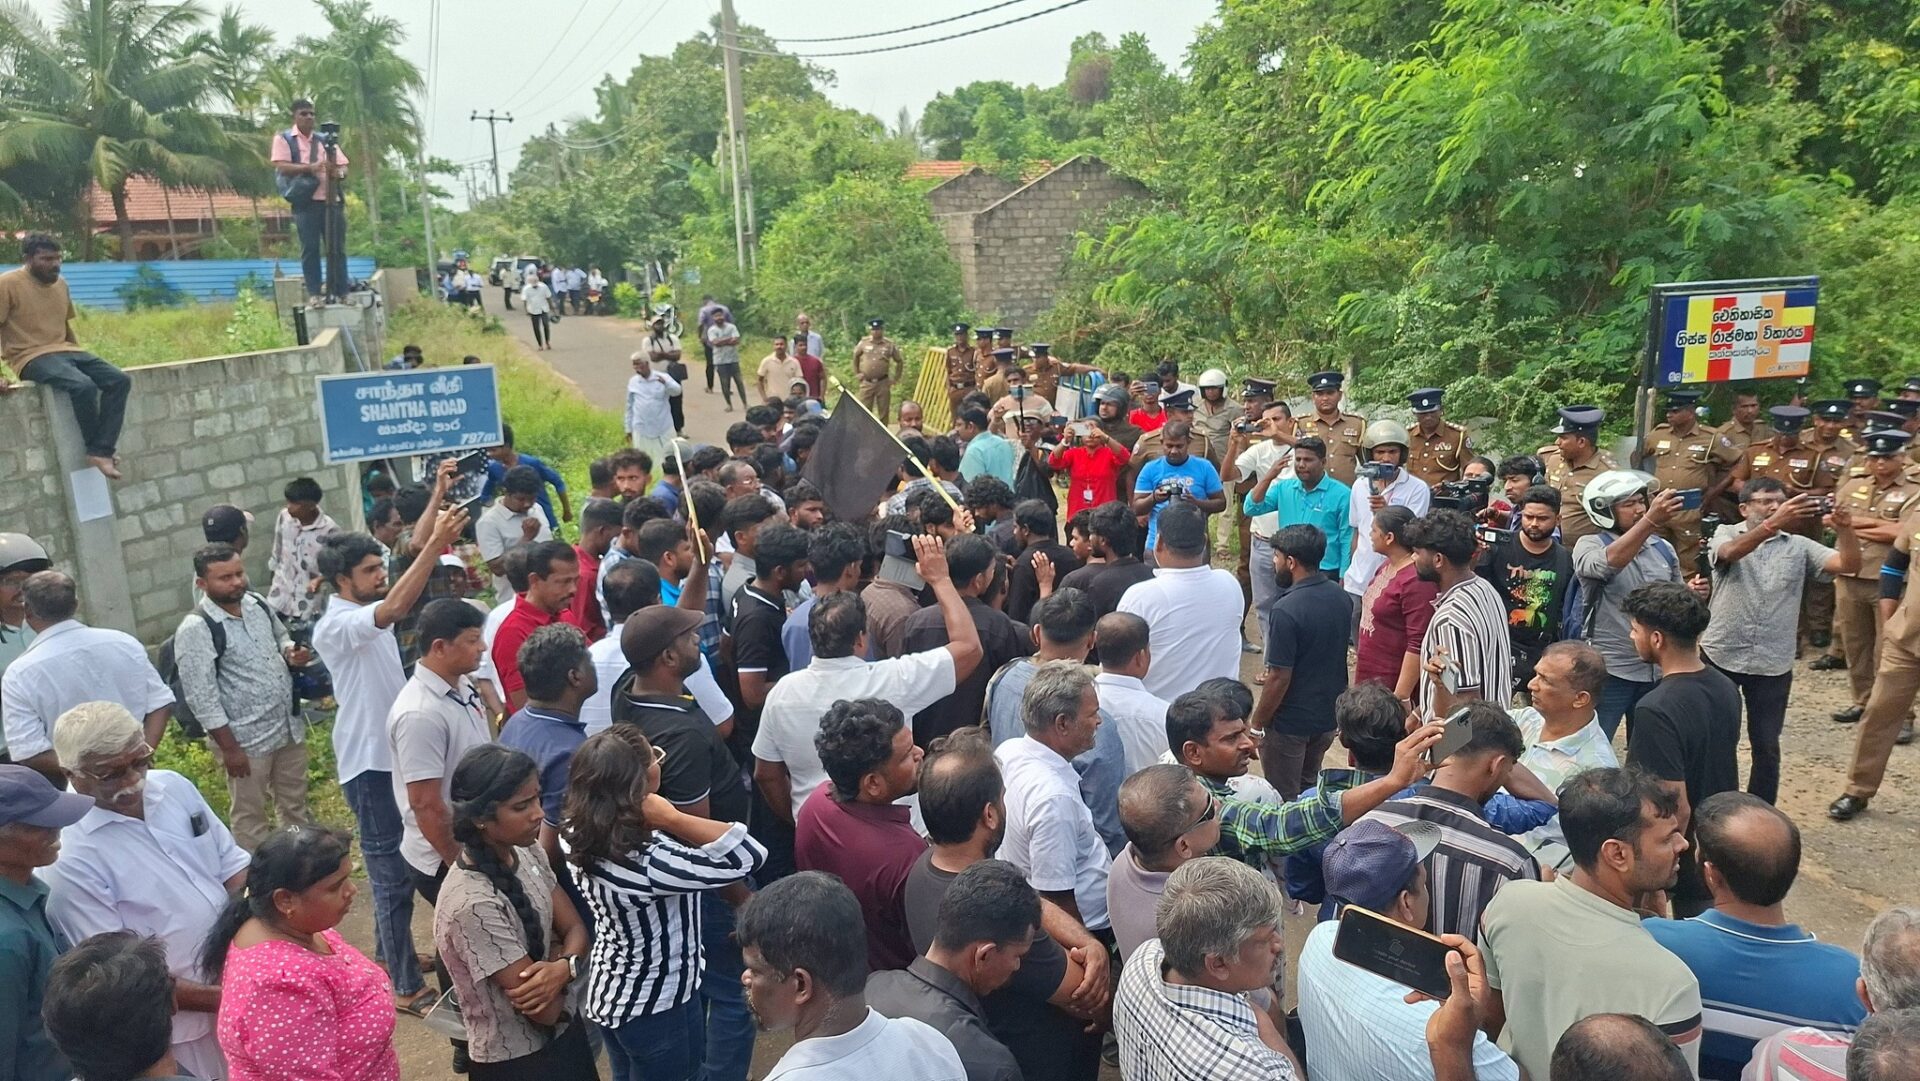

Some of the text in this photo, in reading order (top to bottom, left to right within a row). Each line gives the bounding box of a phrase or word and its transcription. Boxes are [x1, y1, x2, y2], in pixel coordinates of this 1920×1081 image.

[1712, 307, 1774, 323] ඓතිහාසික
[1677, 326, 1804, 347] තිස්ස රාජමහා විහාරය
[355, 379, 424, 401] சாந்தா
[360, 398, 467, 422] SHANTHA ROAD
